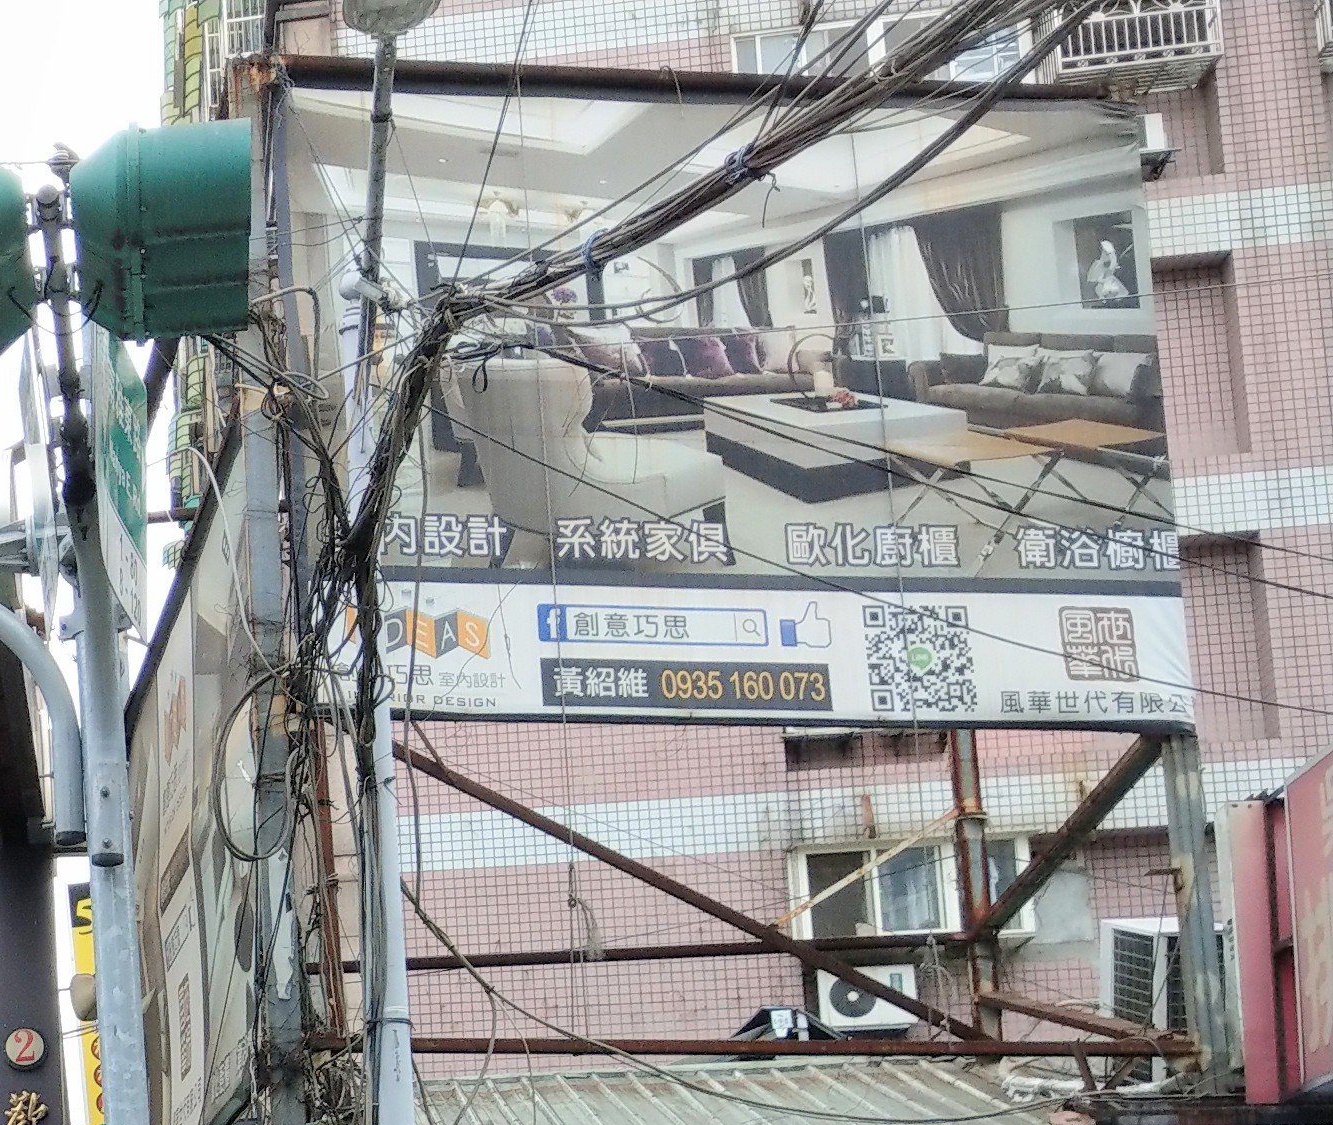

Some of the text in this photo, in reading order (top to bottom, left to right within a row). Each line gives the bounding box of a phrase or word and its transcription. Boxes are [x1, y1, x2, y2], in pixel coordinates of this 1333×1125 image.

[557, 519, 727, 562] 系統家俱
[787, 525, 959, 567] 歐化廚櫃
[386, 619, 480, 648] DEAS
[573, 612, 690, 639] 創意巧思
[439, 672, 506, 690] 室內設計
[553, 667, 826, 701] 黃紹維 0935 160 073
[434, 696, 497, 708] DESIGN
[14, 1028, 36, 1062] 2
